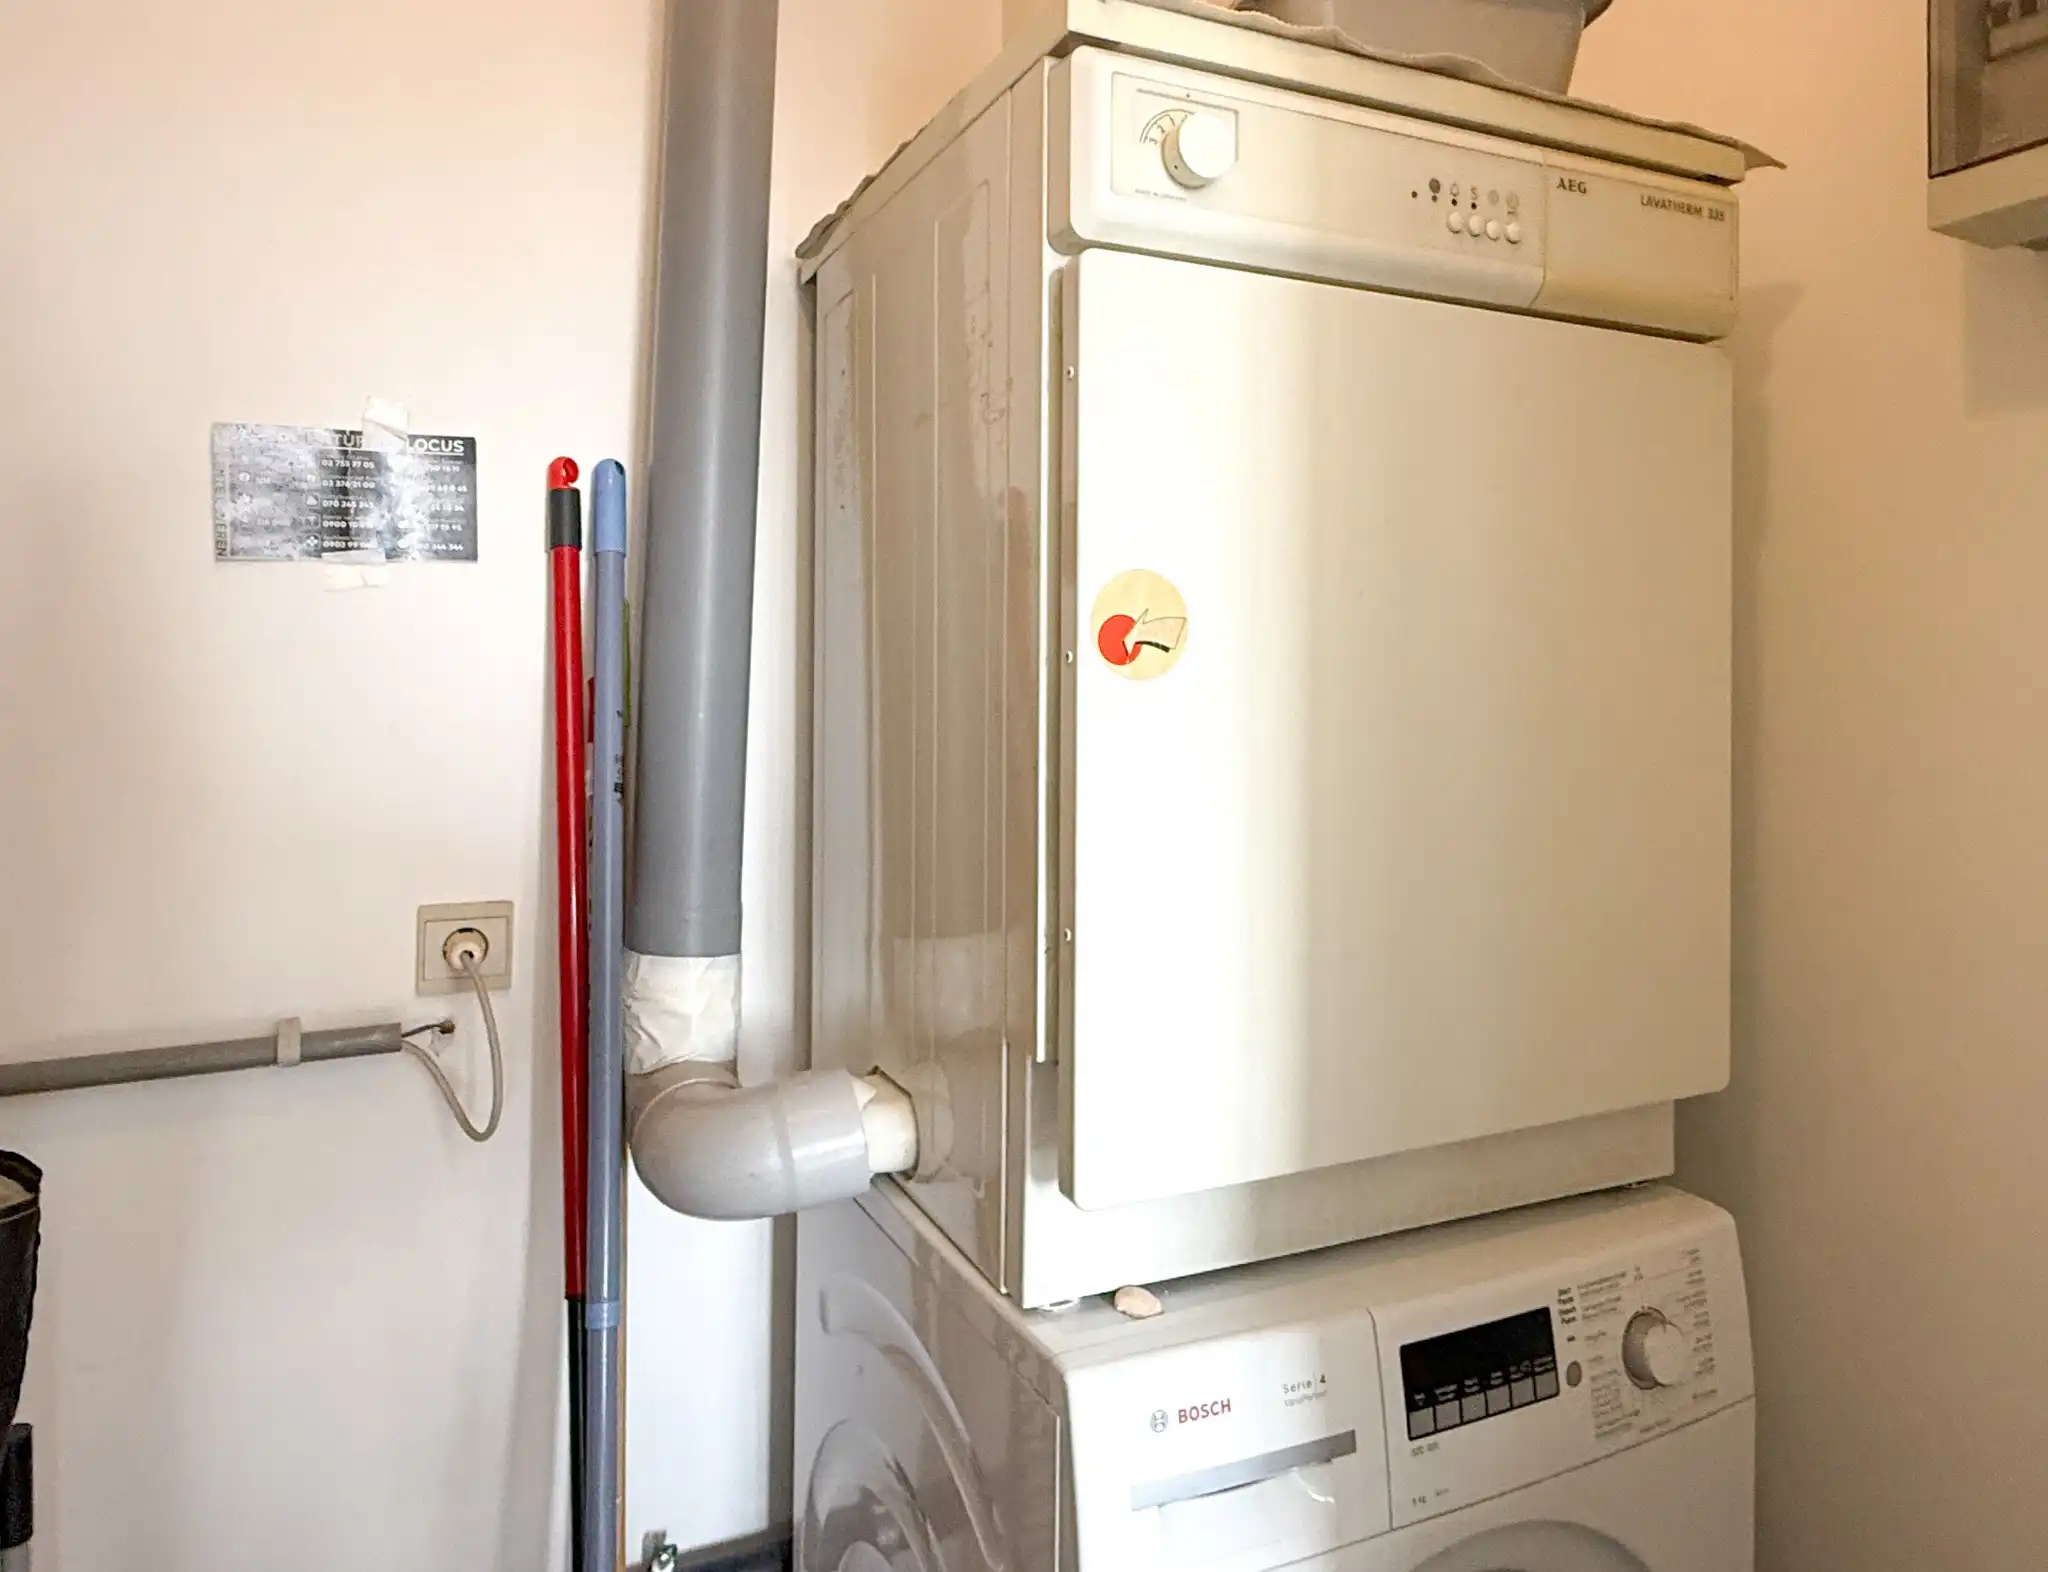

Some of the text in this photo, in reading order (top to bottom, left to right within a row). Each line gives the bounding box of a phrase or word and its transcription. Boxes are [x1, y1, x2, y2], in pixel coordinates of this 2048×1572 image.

[1556, 177, 1587, 194] AEG
[1640, 194, 1703, 217] LAVATHERM
[1283, 1373, 1327, 1394] Serie 4
[1178, 1397, 1232, 1424] BOSCH
